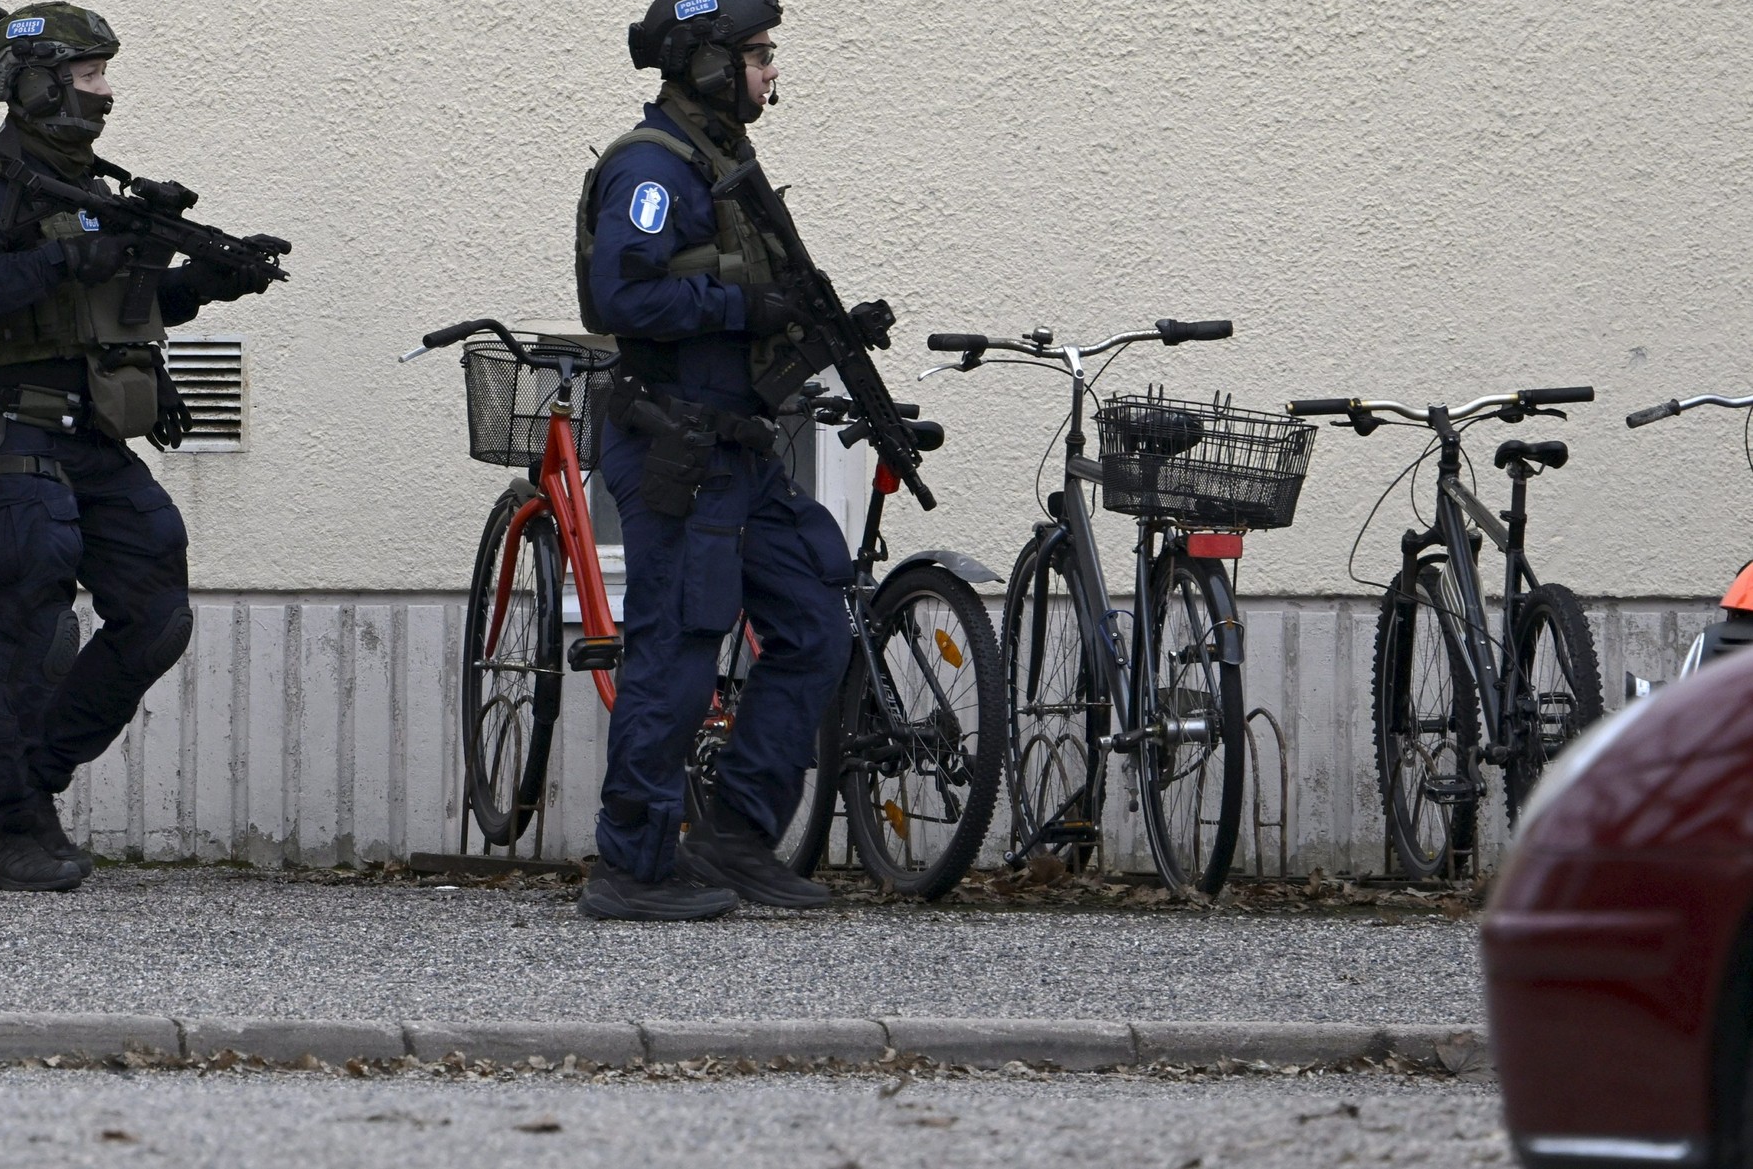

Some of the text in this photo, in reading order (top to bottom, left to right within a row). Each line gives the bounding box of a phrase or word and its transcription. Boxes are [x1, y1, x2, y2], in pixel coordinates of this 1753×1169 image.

[684, 3, 709, 14] POLIS
[11, 20, 40, 30] POLIISI
[13, 26, 36, 34] POLIS
